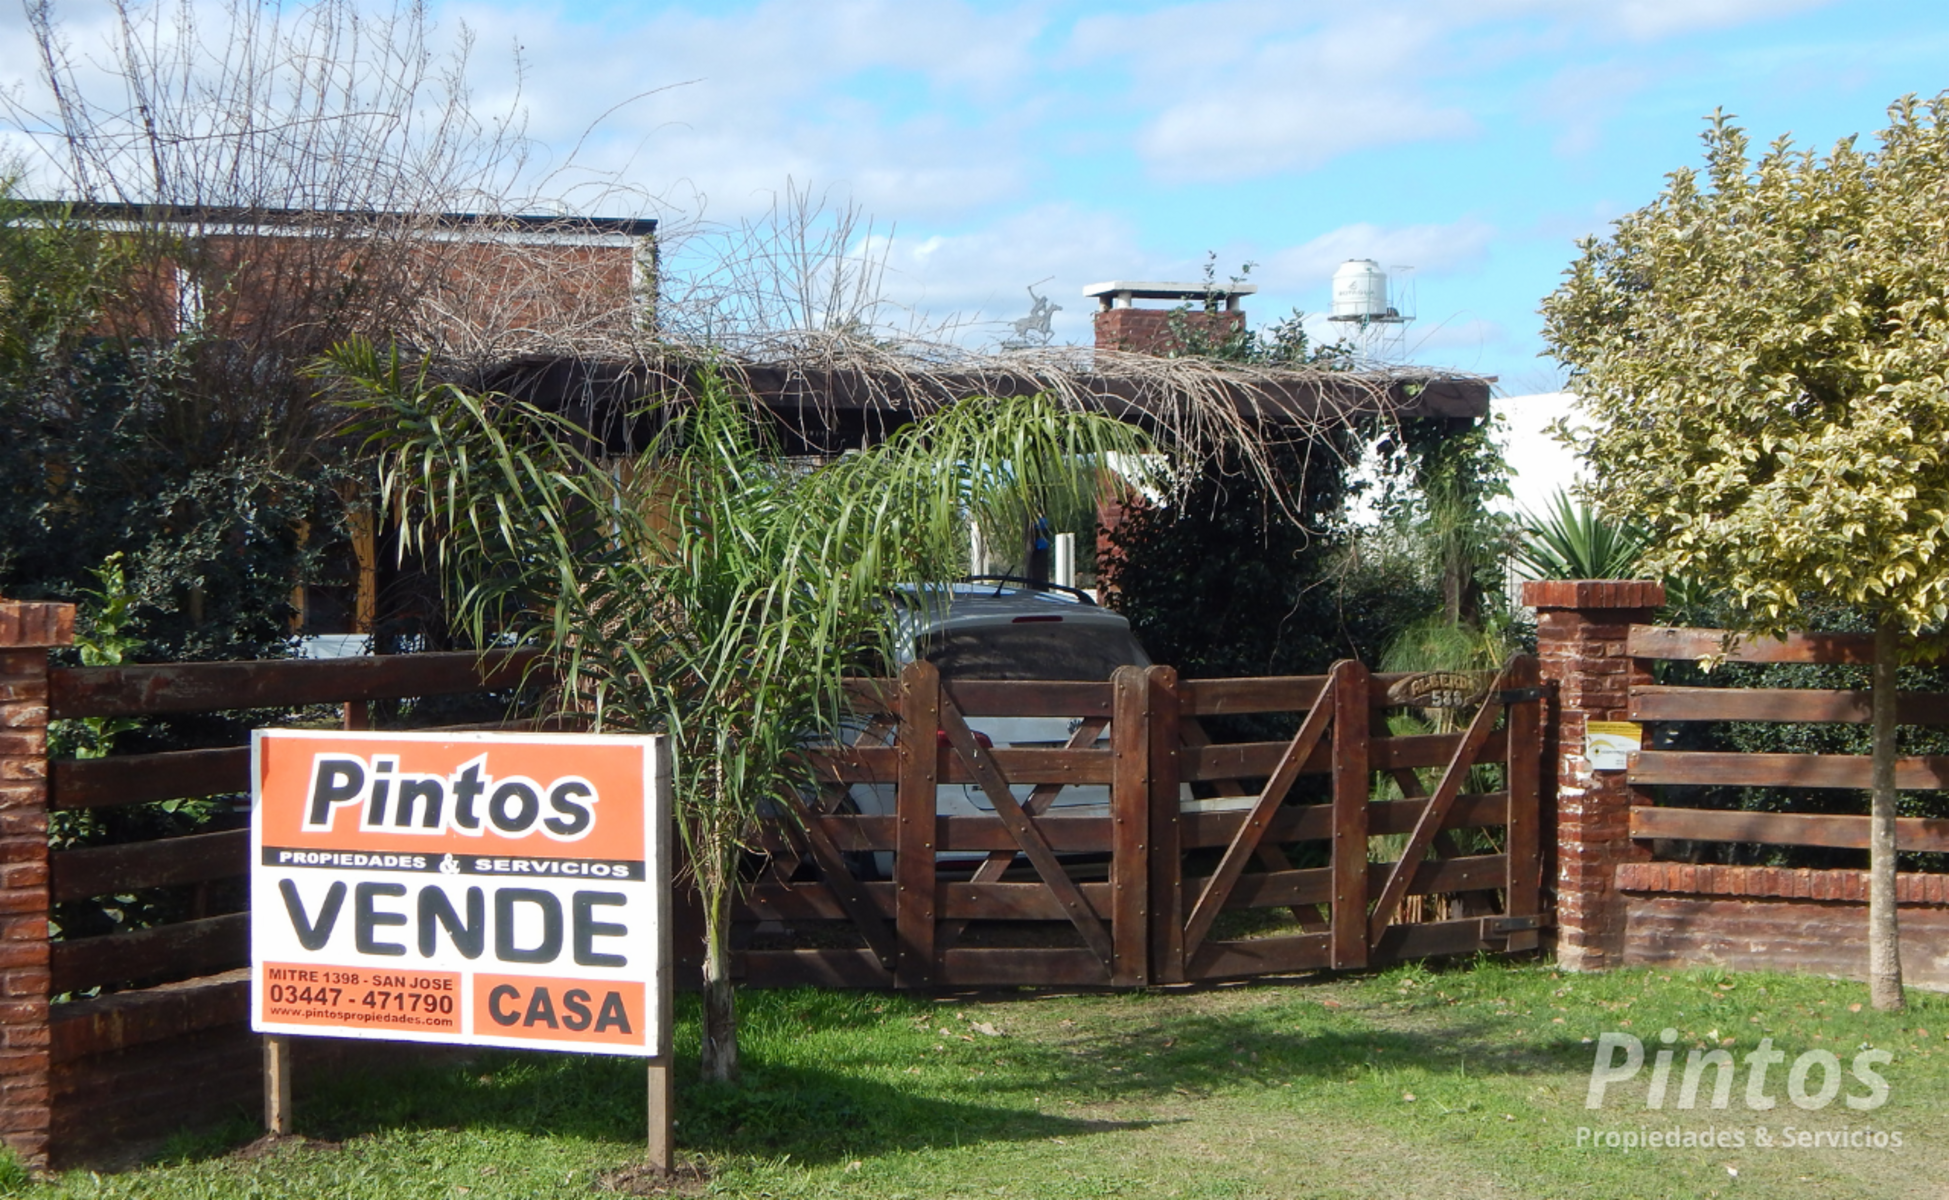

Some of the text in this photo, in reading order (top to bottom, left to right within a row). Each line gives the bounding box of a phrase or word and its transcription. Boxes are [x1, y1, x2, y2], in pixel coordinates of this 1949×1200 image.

[306, 757, 595, 839] Pintos
[278, 850, 630, 878] PROPIEDADES & SERVICIOS
[278, 878, 629, 968] VENDE
[268, 967, 320, 983] MITRE
[322, 971, 360, 985] 1398
[372, 974, 407, 988] SAN
[409, 977, 453, 991] JOSE
[269, 983, 343, 1007] 03447
[361, 990, 454, 1015] 471790
[488, 984, 632, 1036] CASA
[269, 1006, 454, 1027] www.pintospropiedades.com
